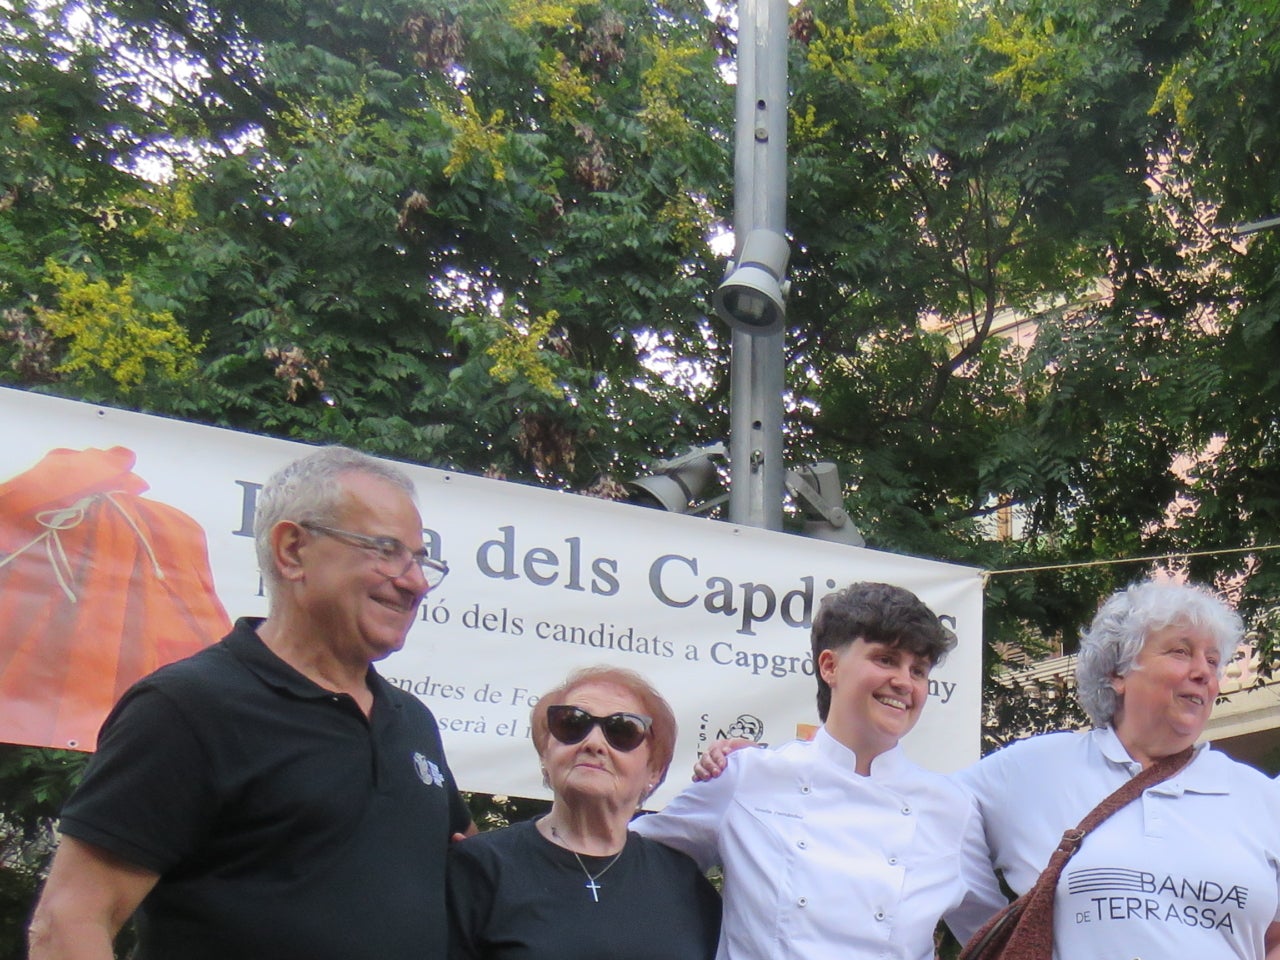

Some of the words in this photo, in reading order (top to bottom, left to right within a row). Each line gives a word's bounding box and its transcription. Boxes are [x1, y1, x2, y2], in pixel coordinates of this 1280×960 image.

[476, 525, 620, 597] dels
[462, 604, 524, 636] dels
[535, 623, 674, 658] candidats
[684, 644, 699, 661] a
[710, 641, 816, 677] Capgrò
[474, 683, 503, 704] de
[438, 716, 487, 735] serà
[496, 719, 517, 737] el
[1075, 911, 1091, 924] DE
[1091, 897, 1235, 935] TERRASSA
